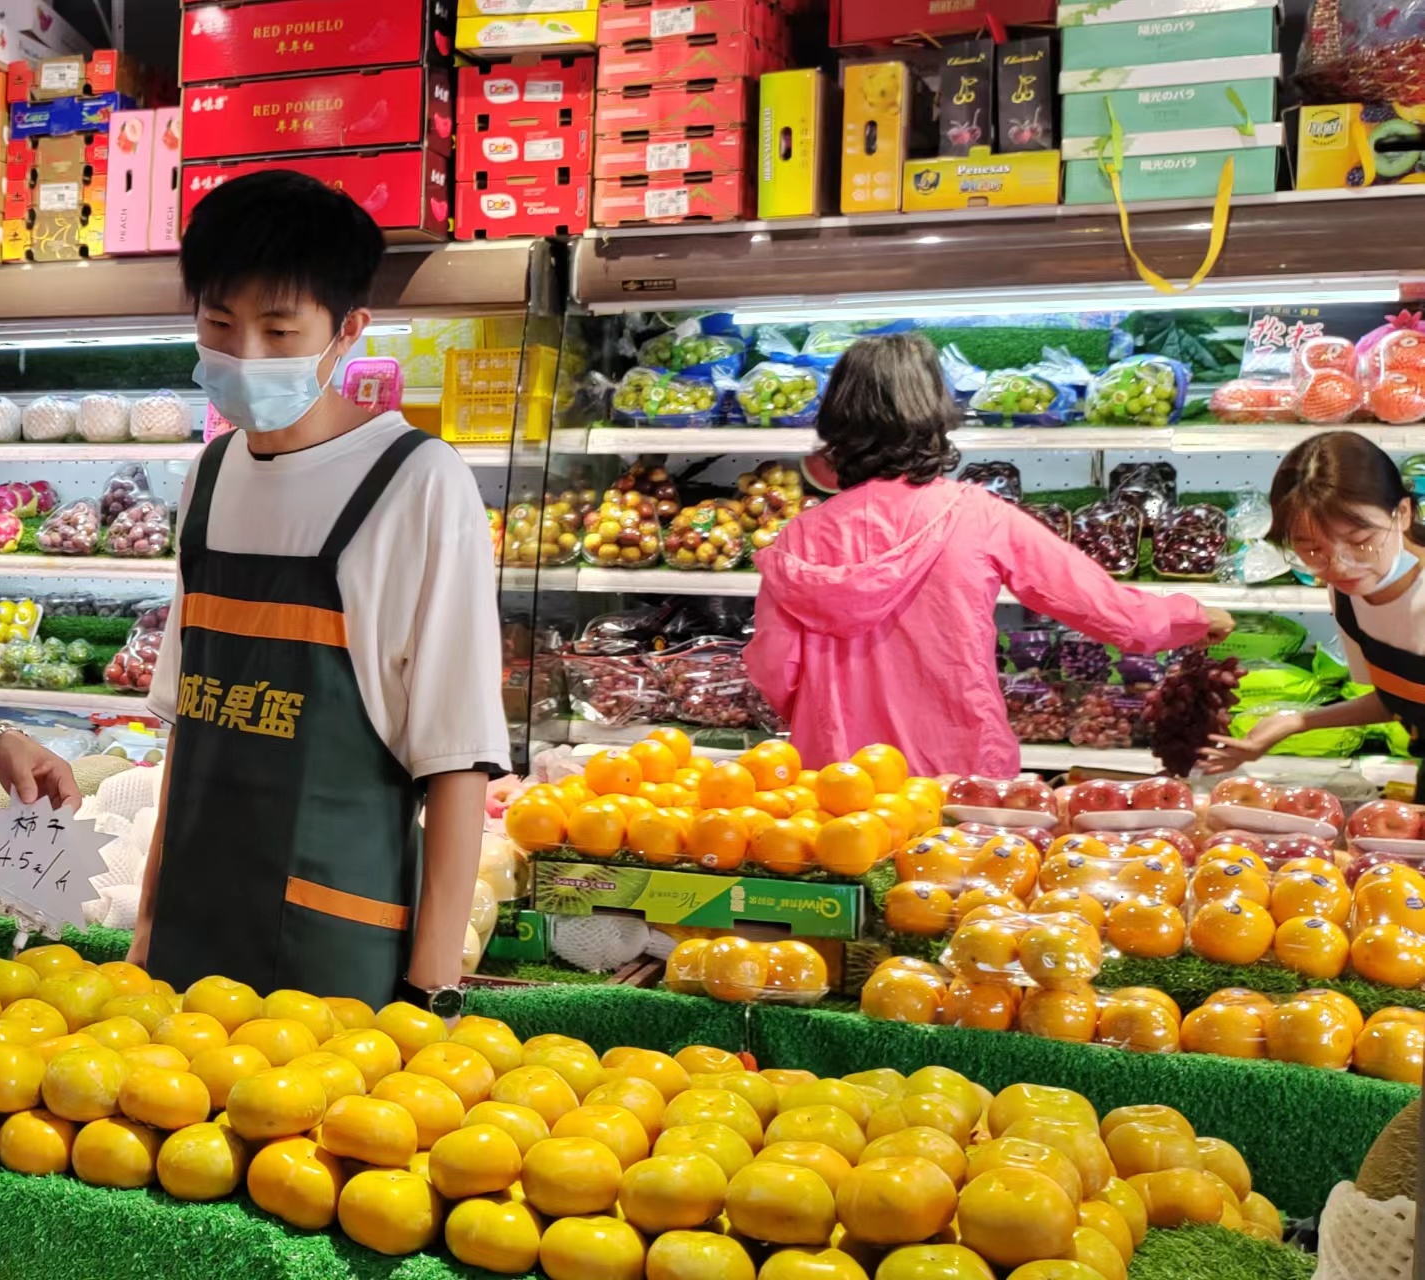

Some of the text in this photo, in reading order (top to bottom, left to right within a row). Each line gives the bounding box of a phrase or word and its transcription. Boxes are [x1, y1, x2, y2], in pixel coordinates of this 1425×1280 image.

[253, 19, 343, 39] RED POMELO
[253, 98, 343, 117] RED POMELO
[488, 142, 513, 154] Dole
[487, 199, 511, 211] Dole
[119, 208, 128, 242] PEACH
[165, 206, 174, 241] PEACH
